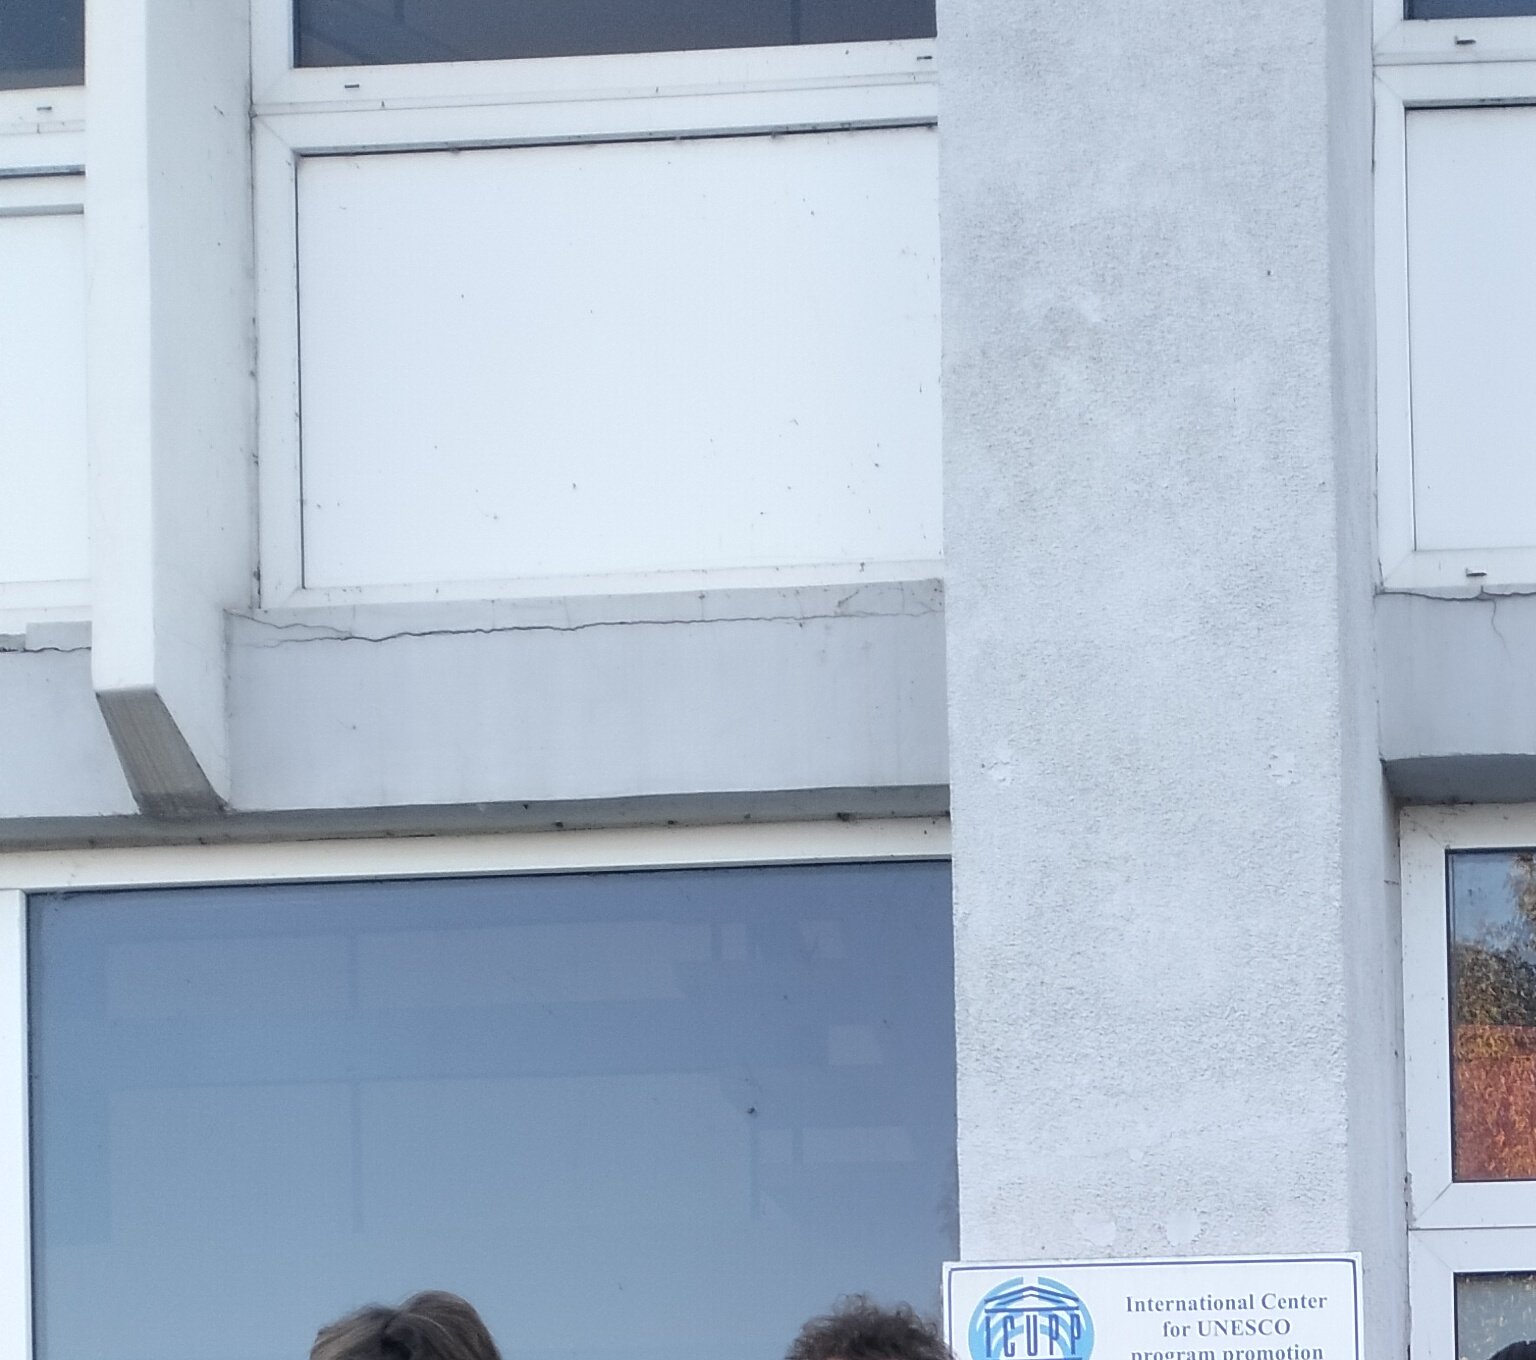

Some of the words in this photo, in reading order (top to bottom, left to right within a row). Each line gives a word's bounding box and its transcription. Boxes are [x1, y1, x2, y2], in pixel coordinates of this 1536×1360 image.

[1126, 1293, 1254, 1313] International
[1261, 1292, 1328, 1310] Center
[985, 1313, 1081, 1358] ICUPP
[1162, 1320, 1191, 1338] for
[1197, 1318, 1291, 1337] UNESCO
